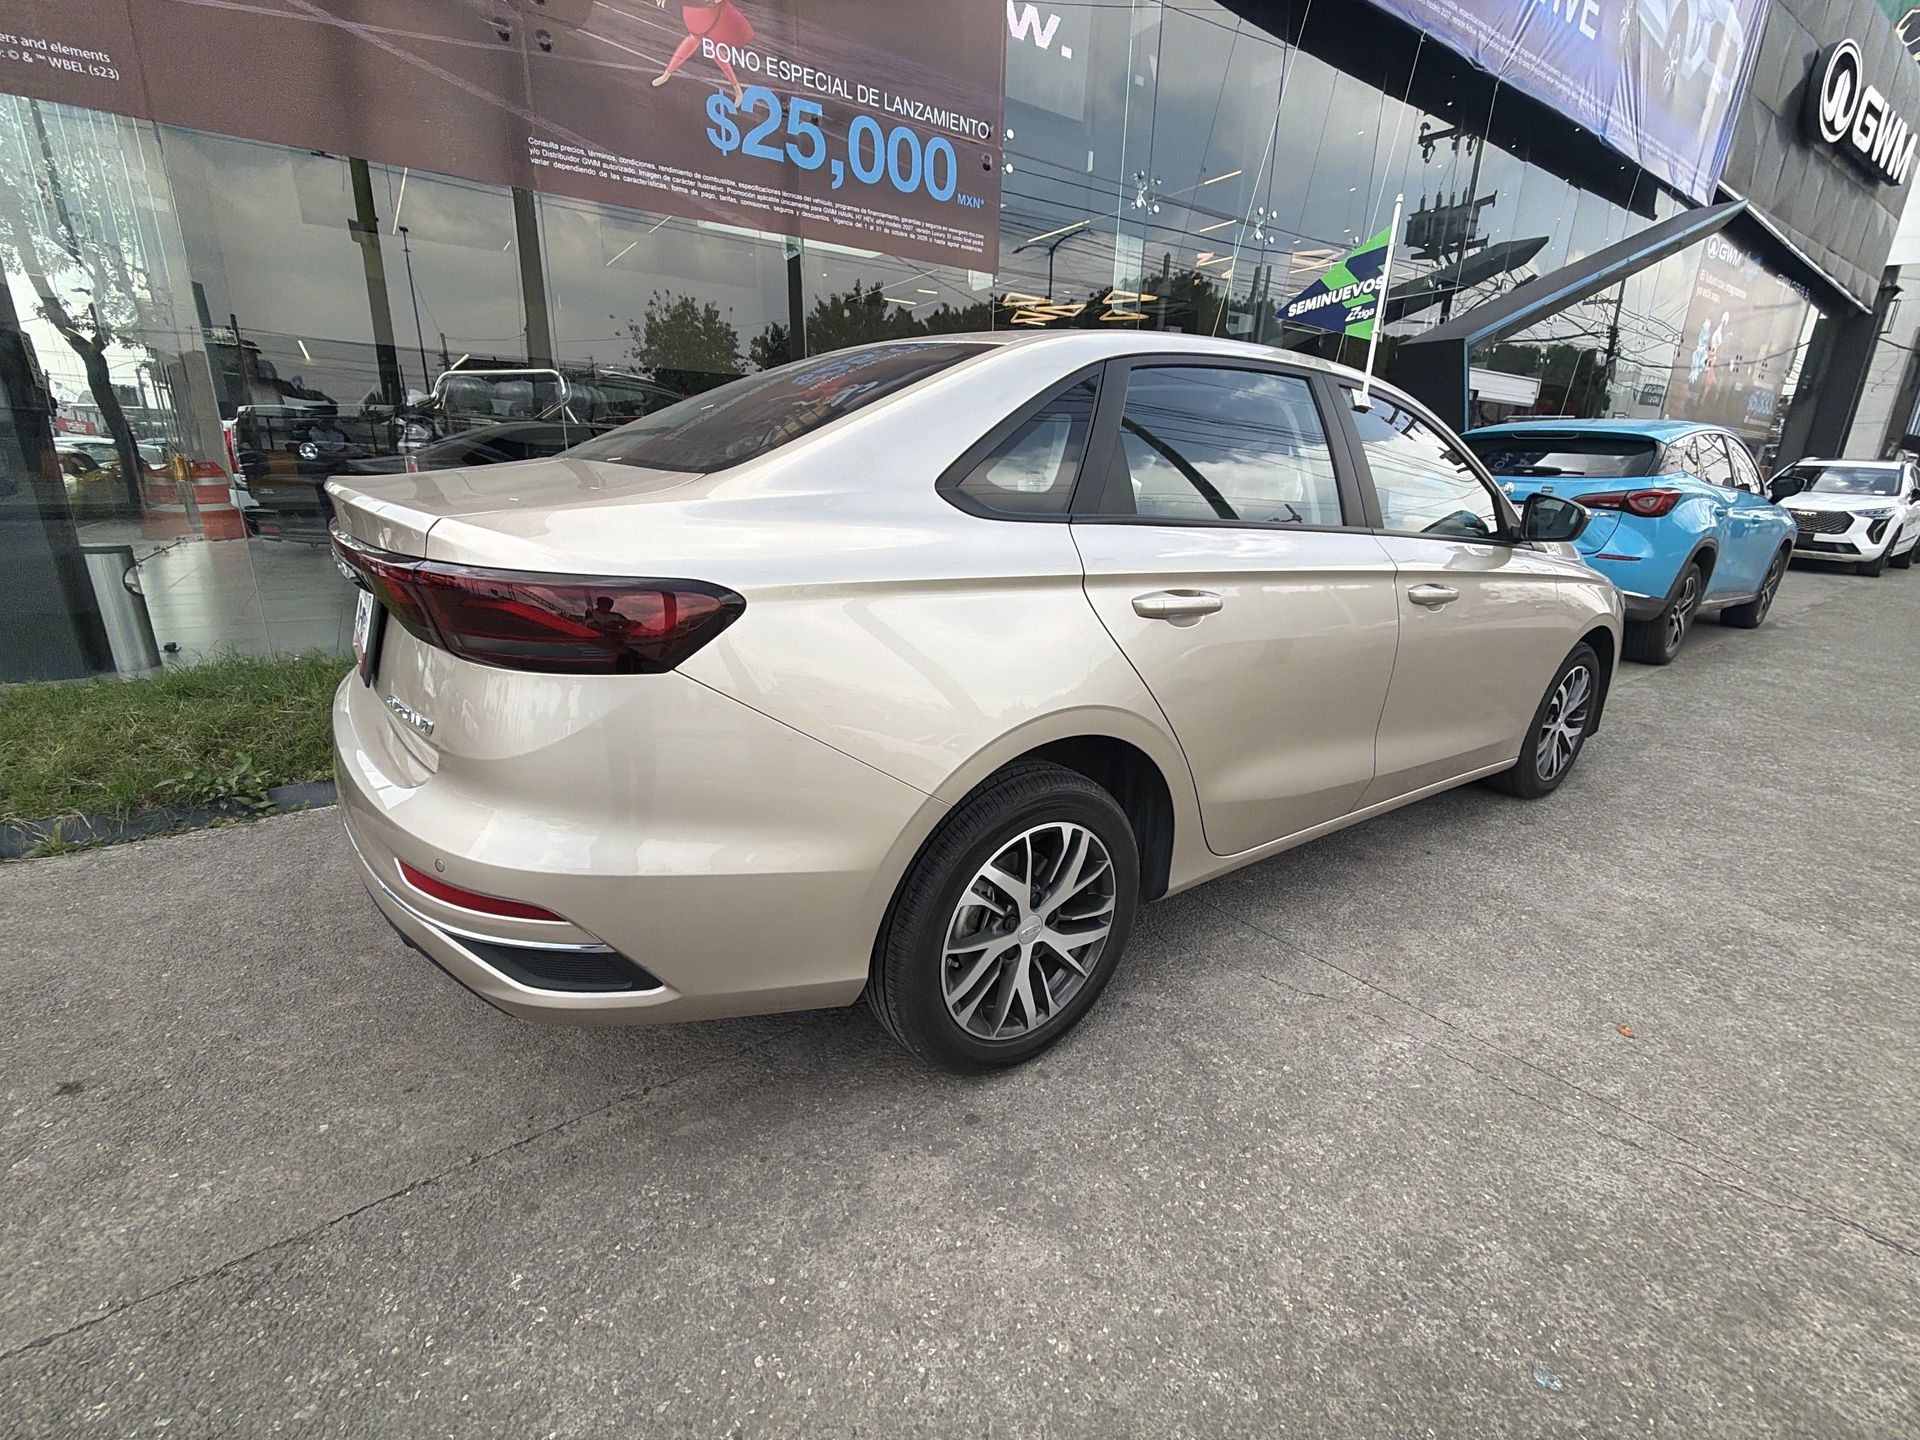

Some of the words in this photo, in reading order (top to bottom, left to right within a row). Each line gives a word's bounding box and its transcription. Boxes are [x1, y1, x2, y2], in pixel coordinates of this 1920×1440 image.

[20, 37, 47, 50] and
[50, 42, 111, 63] elements
[22, 51, 33, 63] &
[48, 56, 86, 74] WBEL
[89, 64, 120, 81] (s23)
[702, 37, 760, 72] BONO
[766, 57, 853, 100] ESPECIAL
[857, 84, 879, 108] DE
[885, 93, 990, 139] LANZAMIENTO
[706, 84, 958, 202] $25,000
[1852, 85, 1918, 185] GWM
[528, 137, 558, 149] Consulta
[560, 145, 585, 156] precios,
[618, 157, 656, 170] condiciones,
[658, 166, 692, 177] rendimiento
[738, 182, 780, 195] especificaciones
[834, 202, 859, 212] programas
[529, 147, 539, 155] y/o
[541, 149, 579, 163] Distribuidor
[581, 157, 600, 167] GWM
[602, 163, 636, 174] autorizado.
[638, 169, 661, 179] Imagen
[672, 177, 695, 186] carácter
[726, 187, 755, 198] Promoción
[780, 198, 809, 209] únicamente
[822, 207, 836, 215] GWM
[530, 157, 549, 166] variar
[553, 160, 596, 175] dependiendo
[598, 170, 607, 178] de
[610, 172, 620, 180] las
[622, 176, 668, 190] características,
[670, 184, 688, 194] forma
[690, 188, 698, 196] de
[773, 206, 793, 214] seguros
[832, 216, 852, 226] Vigencia
[1287, 275, 1385, 317] SEMINUEVOS
